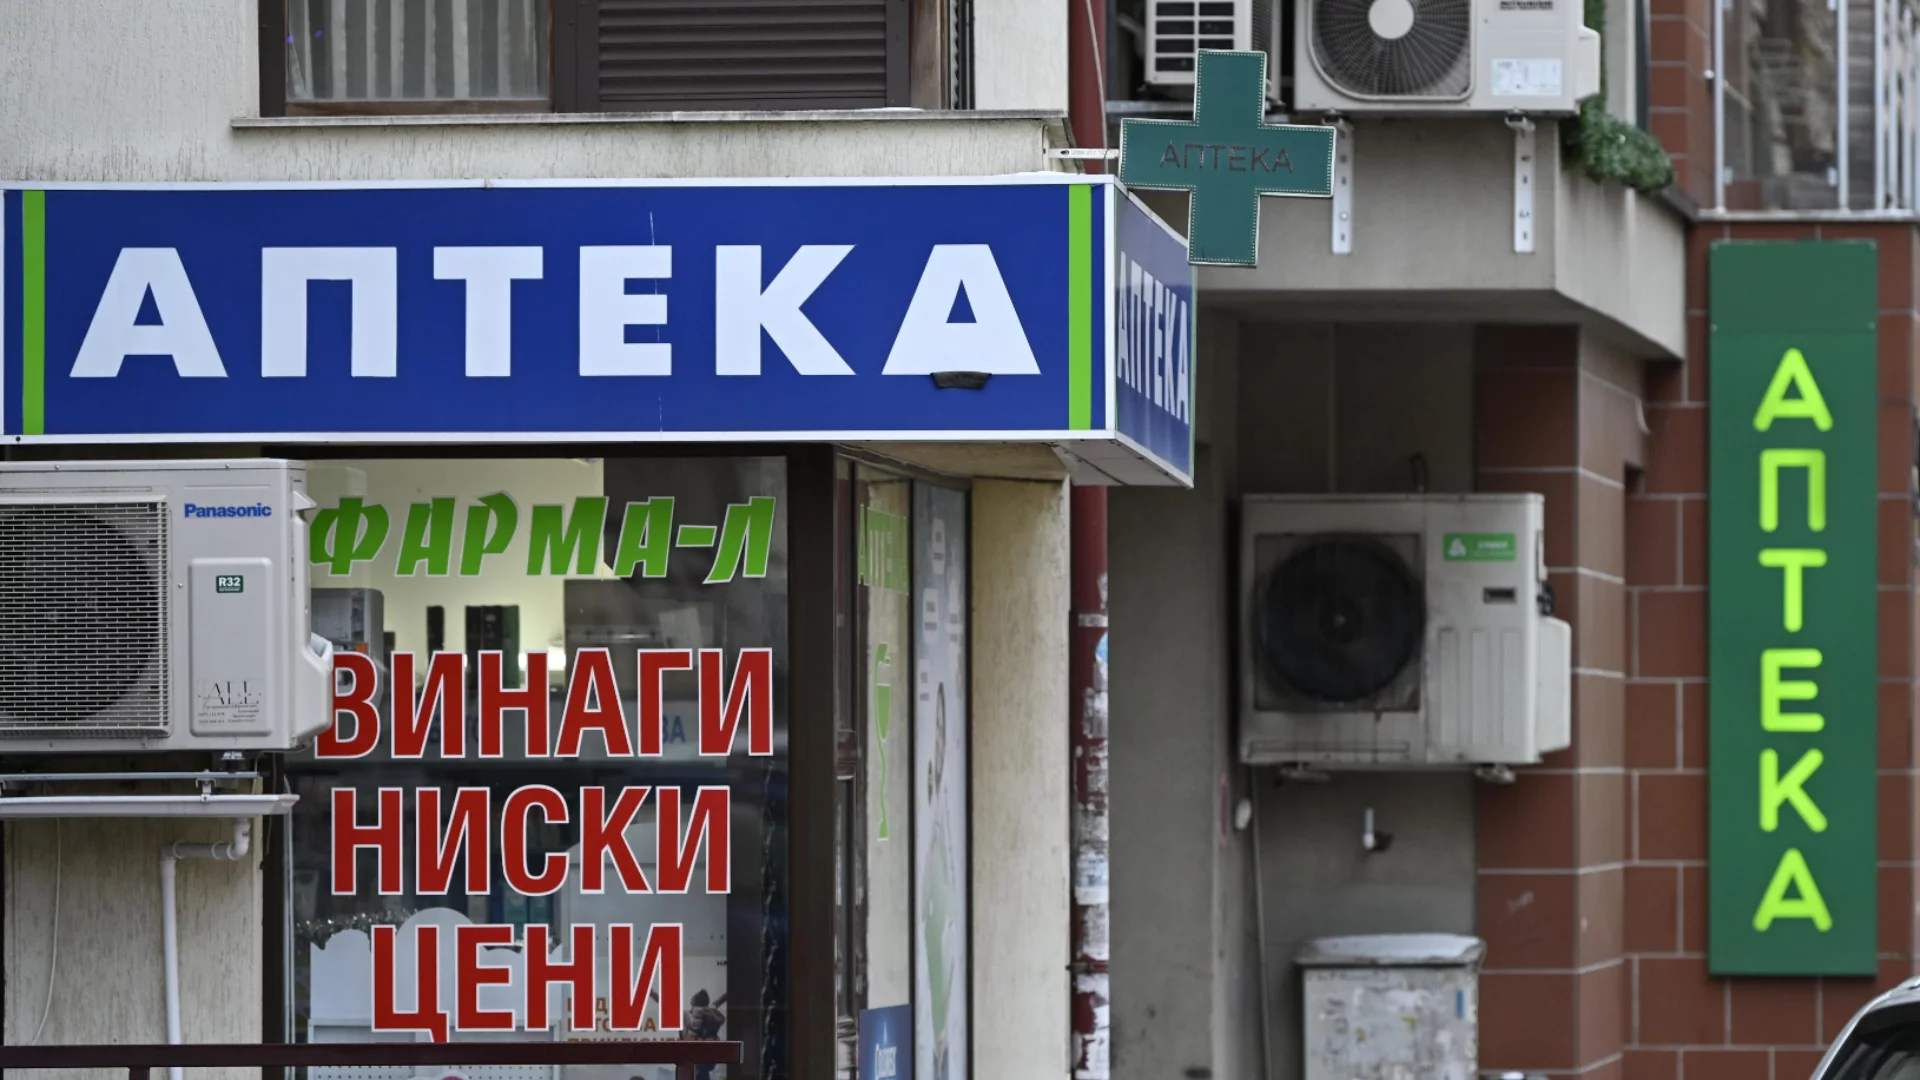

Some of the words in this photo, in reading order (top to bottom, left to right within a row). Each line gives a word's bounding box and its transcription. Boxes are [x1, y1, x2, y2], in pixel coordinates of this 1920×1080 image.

[1160, 140, 1293, 174] АПТЕКА
[70, 243, 1041, 378] АПТЕКА
[1117, 250, 1190, 426] АПТЕКА
[184, 502, 272, 518] Panasonic
[309, 491, 776, 584] ФАРМА-Л
[218, 577, 241, 587] R32
[1753, 347, 1833, 932] АПТЕКА
[314, 647, 774, 759] ВИНАГИ
[331, 785, 731, 896] НИСКИ
[370, 921, 684, 1043] ЦЕНИ
